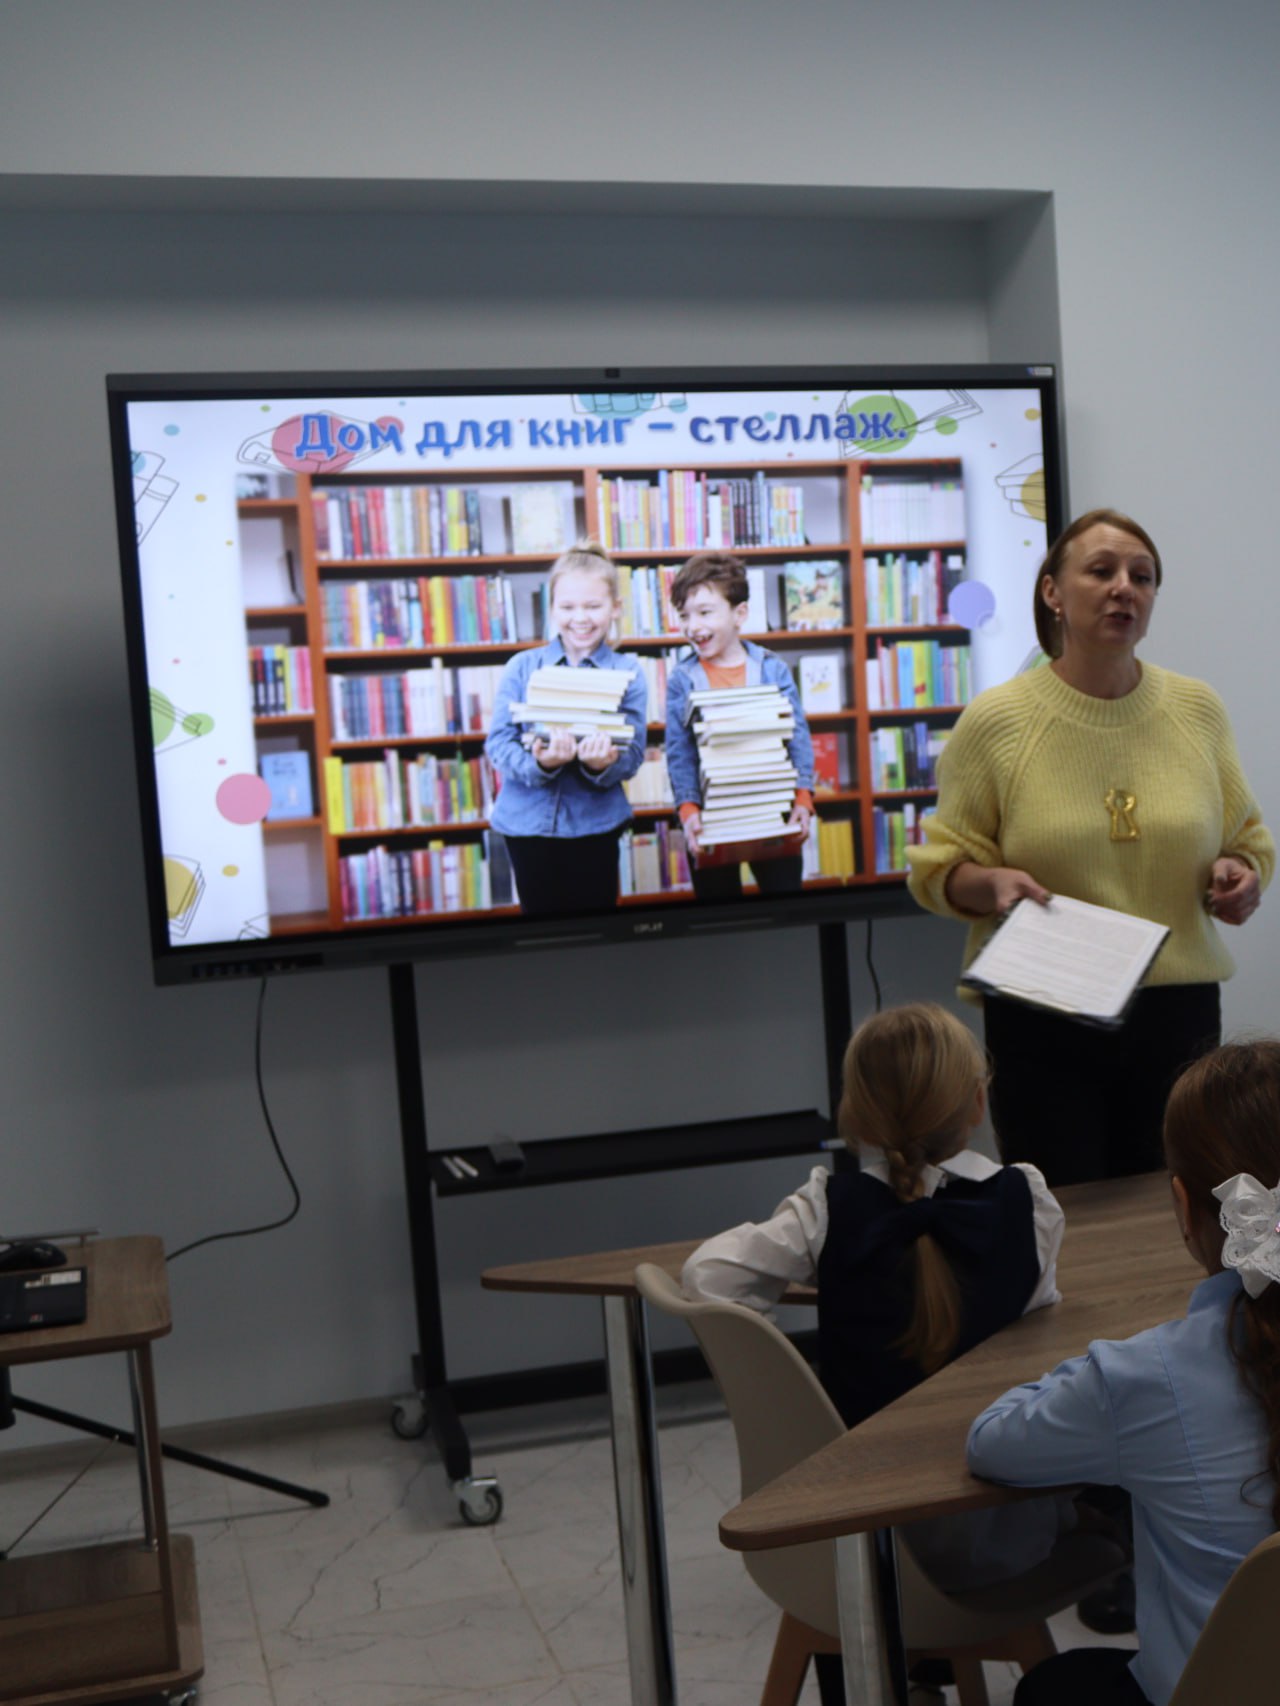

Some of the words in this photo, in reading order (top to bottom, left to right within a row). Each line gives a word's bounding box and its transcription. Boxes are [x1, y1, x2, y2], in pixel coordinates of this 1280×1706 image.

[295, 413, 404, 460] Дом
[415, 417, 511, 457] для
[528, 417, 633, 448] книг
[689, 411, 909, 444] стеллаж.
